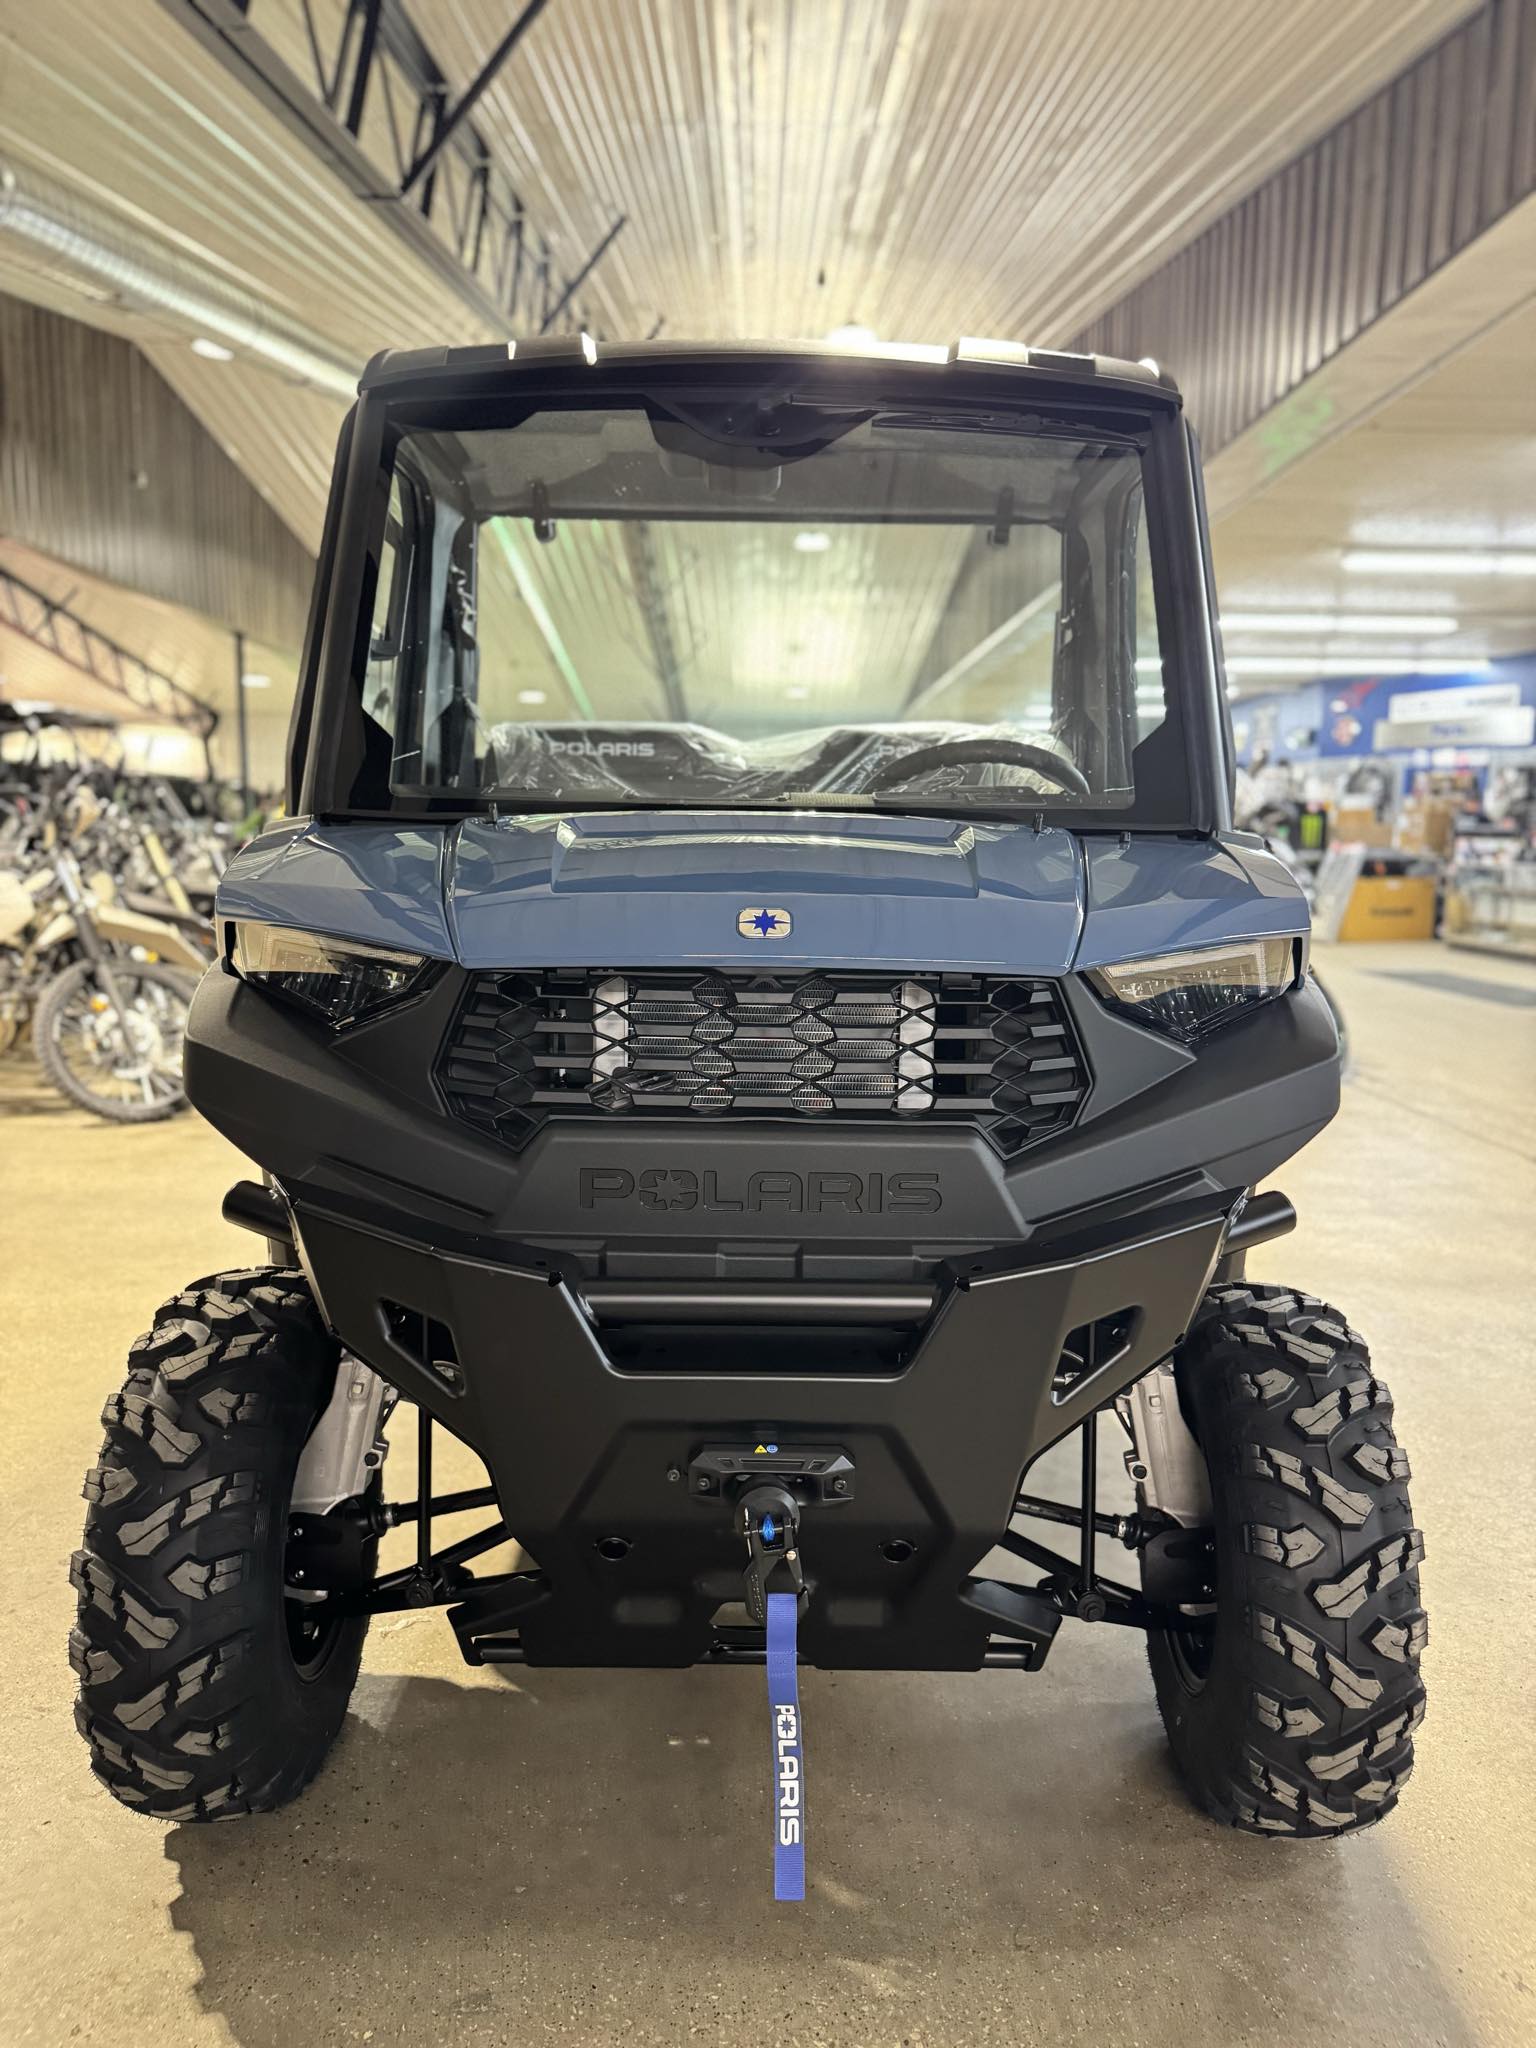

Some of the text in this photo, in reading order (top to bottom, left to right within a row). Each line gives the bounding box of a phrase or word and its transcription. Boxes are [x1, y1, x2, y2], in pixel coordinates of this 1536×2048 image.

[549, 742, 655, 757] POLARIS
[579, 1168, 943, 1214] POLARIS
[775, 1704, 800, 1846] POLARIS
